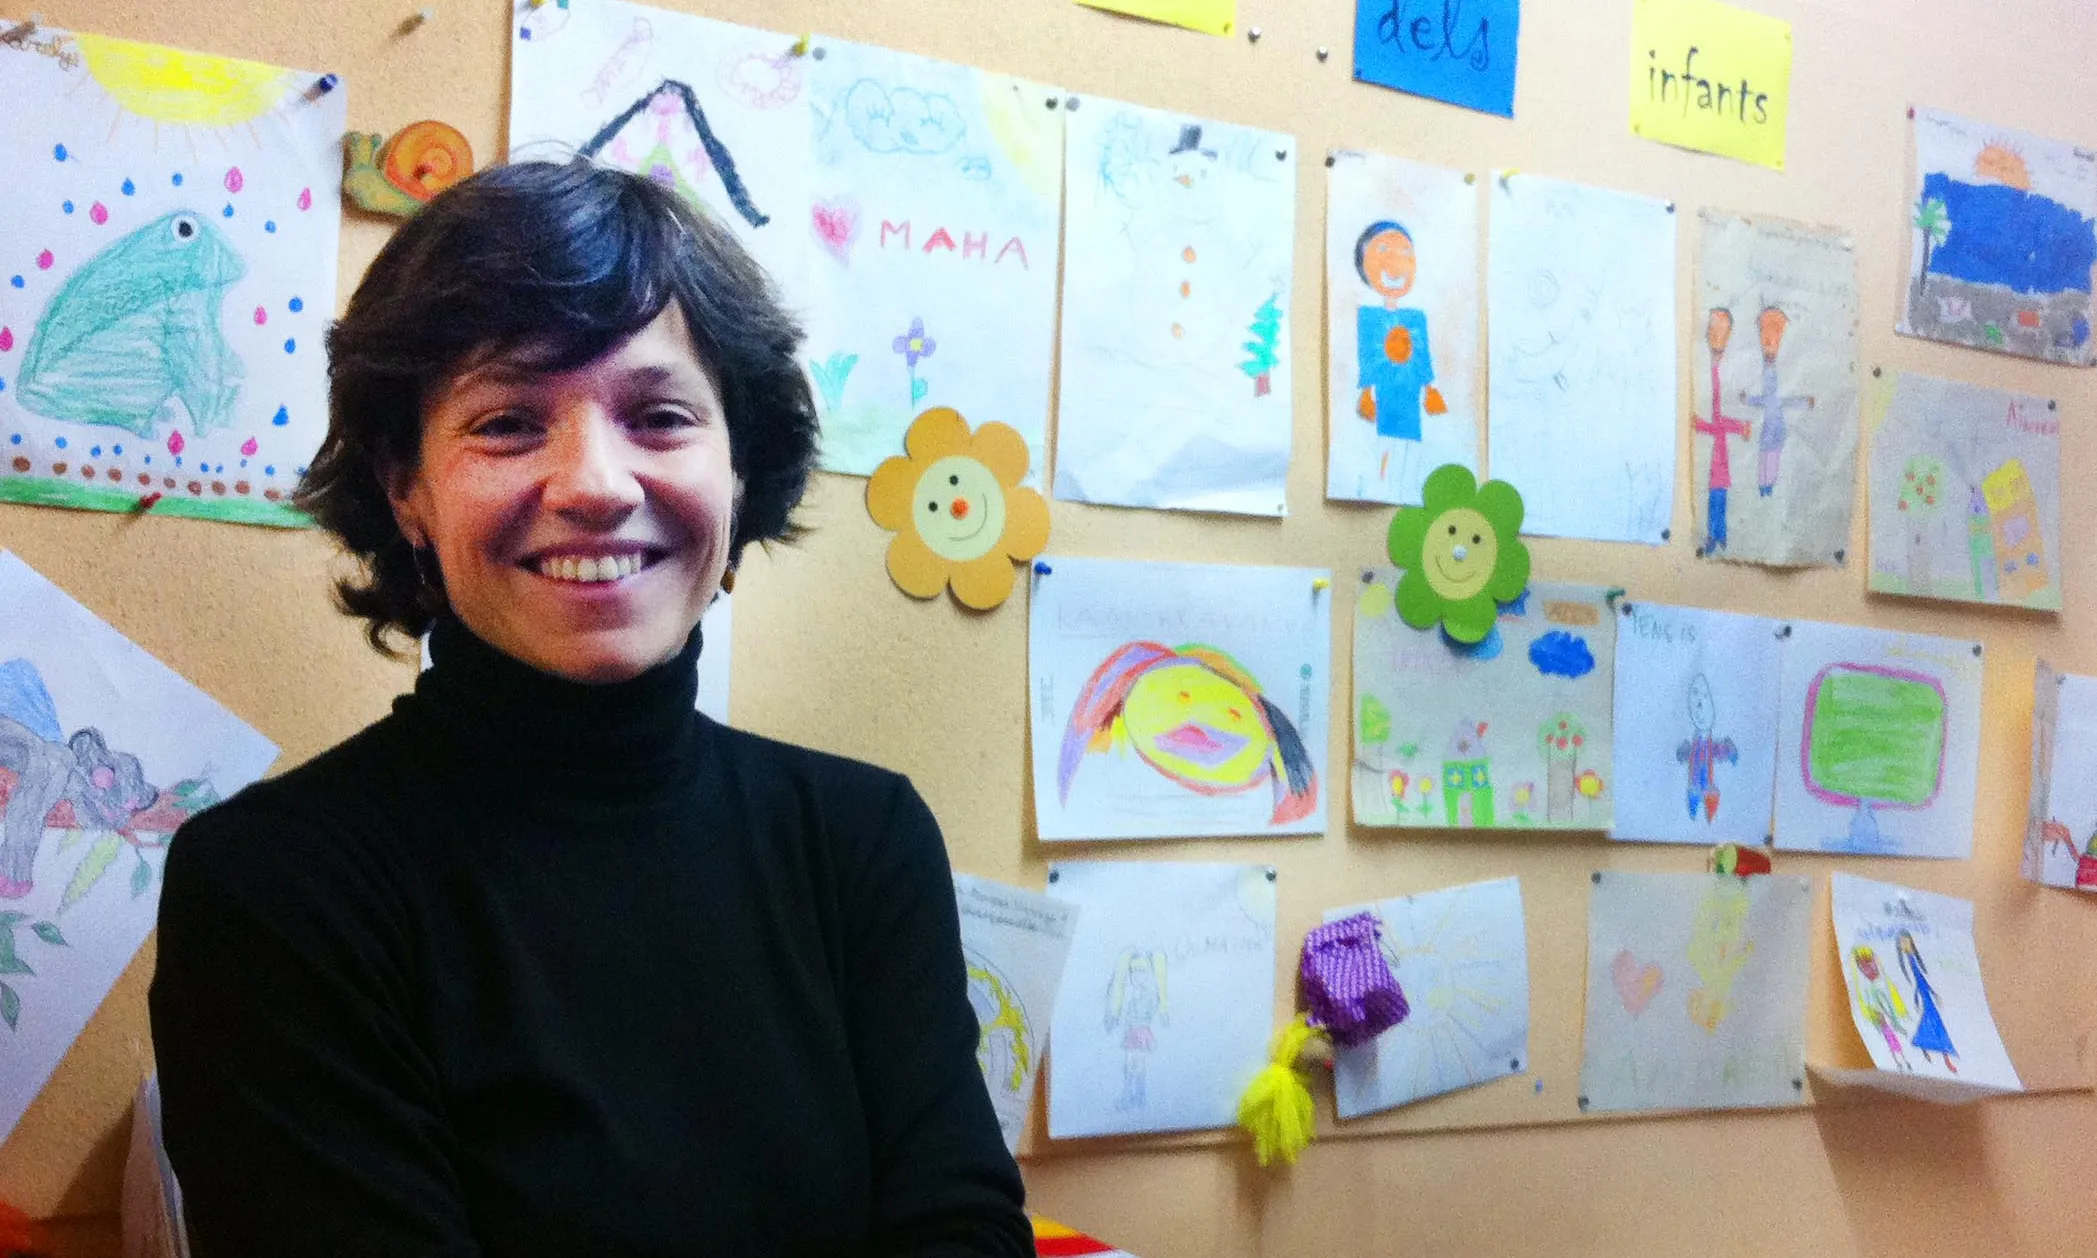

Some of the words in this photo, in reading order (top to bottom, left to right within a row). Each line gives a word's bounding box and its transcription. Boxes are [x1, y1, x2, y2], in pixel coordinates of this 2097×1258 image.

[1378, 0, 1489, 71] dels
[1649, 46, 1768, 124] infants
[880, 217, 1030, 271] MAHA
